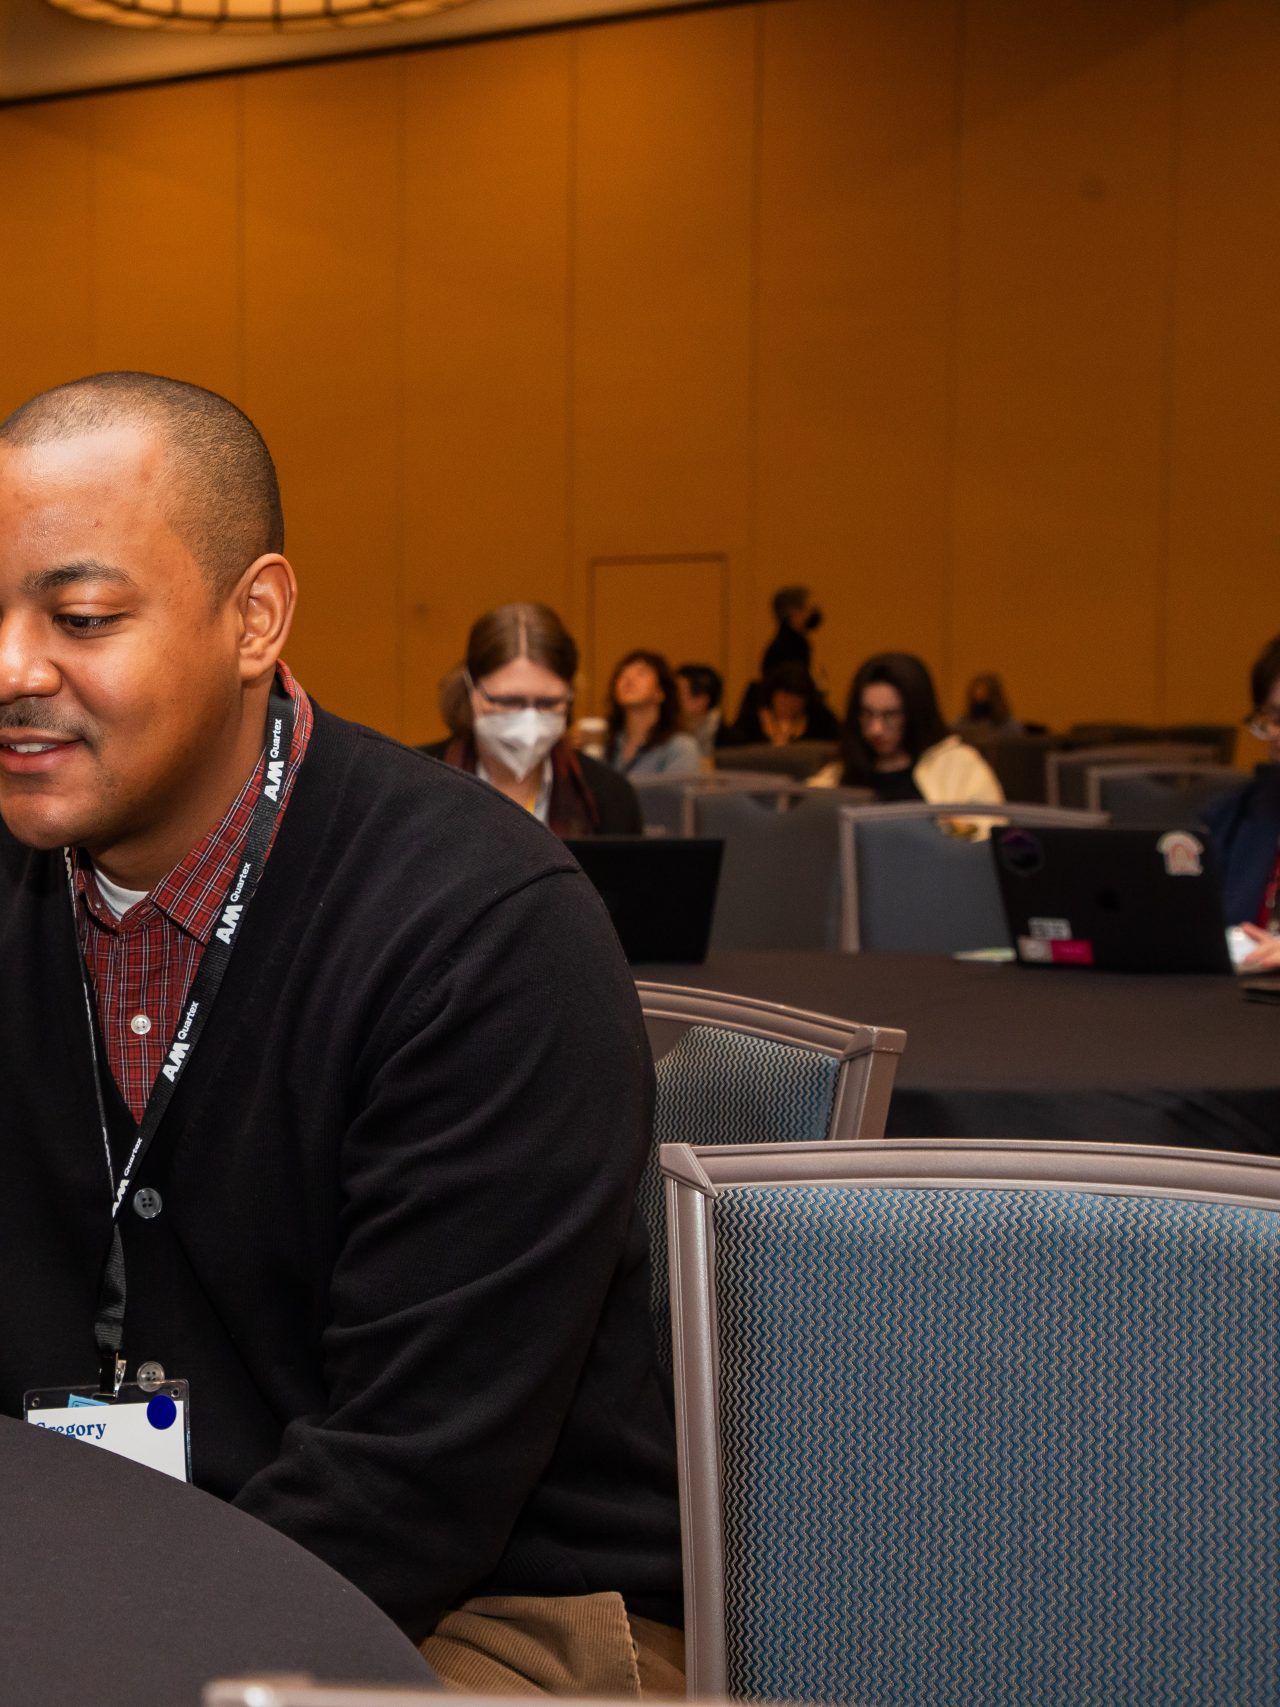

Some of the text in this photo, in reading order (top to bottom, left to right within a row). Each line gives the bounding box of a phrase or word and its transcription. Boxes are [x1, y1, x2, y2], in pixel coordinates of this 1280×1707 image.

[264, 718, 284, 802] AM Quartex
[216, 862, 251, 945] AM Quartex
[162, 1000, 199, 1082] AM Quartex
[124, 1137, 143, 1177] Quartex
[36, 1421, 107, 1440] egory
